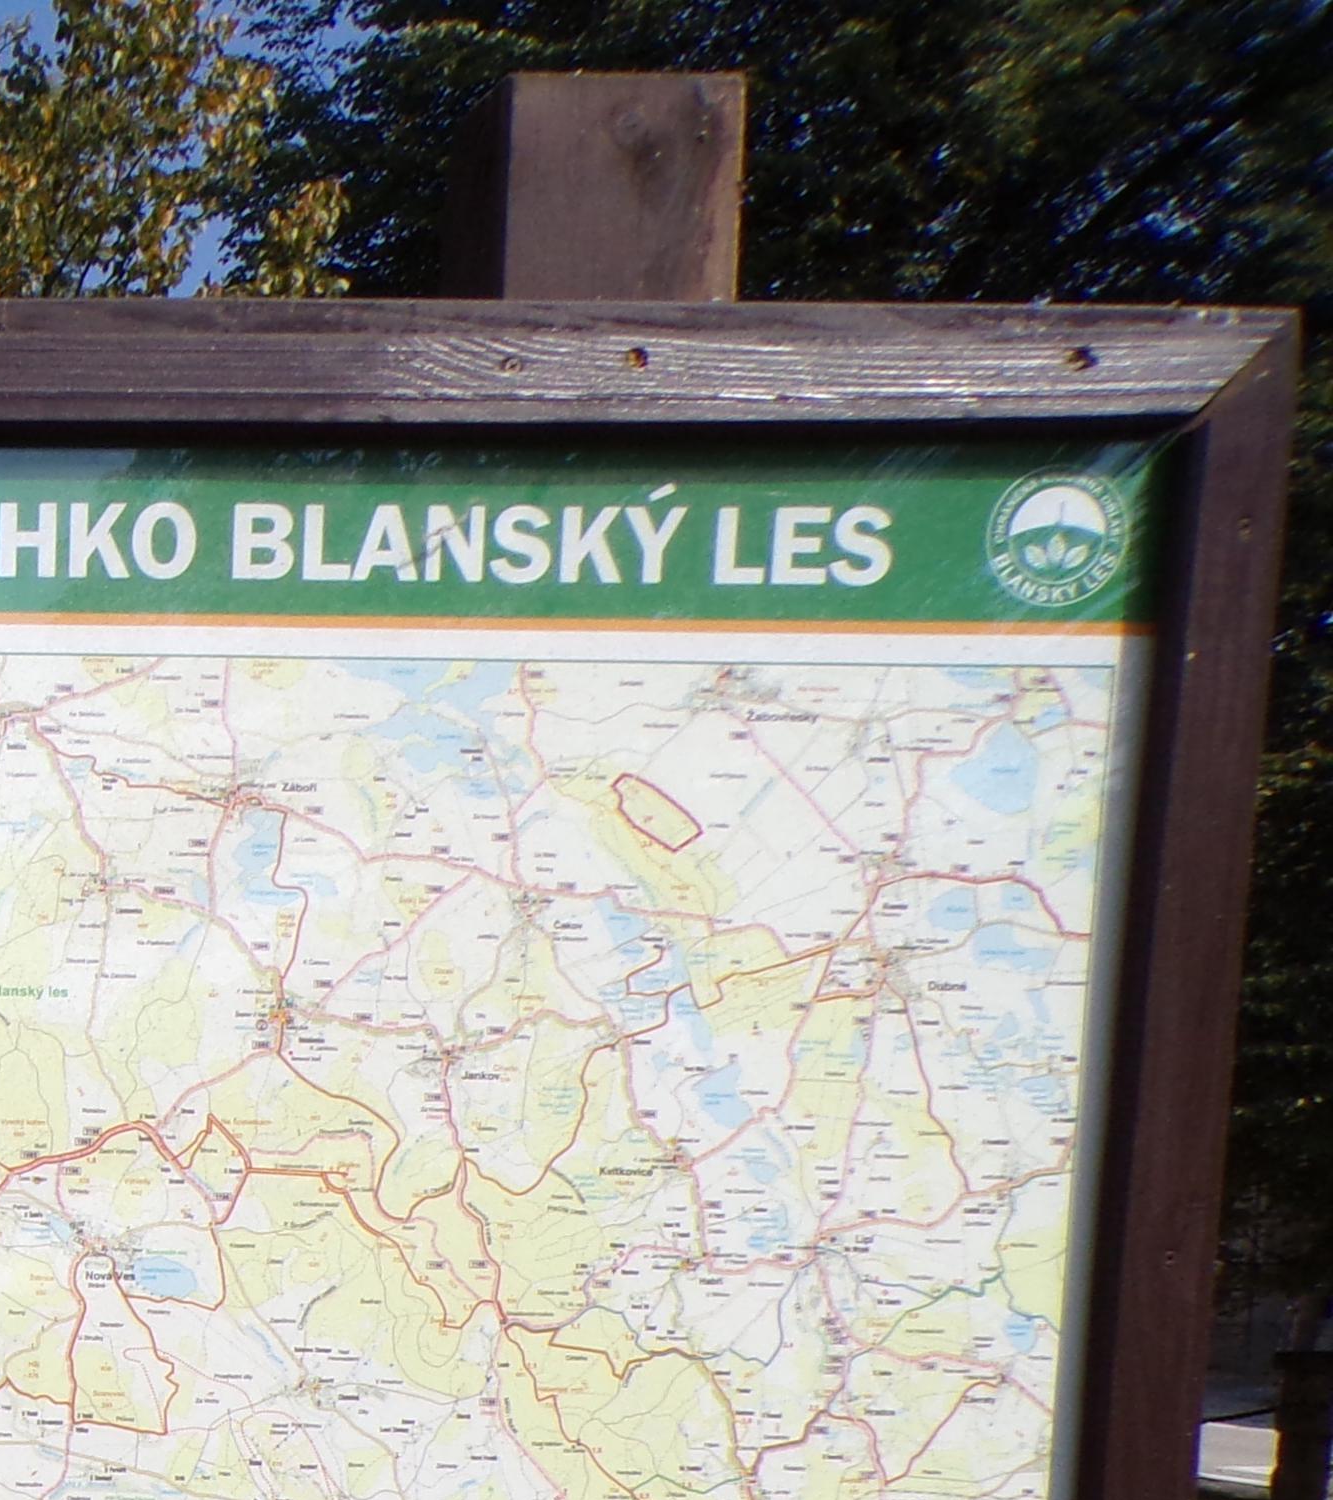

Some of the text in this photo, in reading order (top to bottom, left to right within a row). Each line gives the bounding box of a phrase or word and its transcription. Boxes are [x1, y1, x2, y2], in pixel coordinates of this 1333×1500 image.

[229, 481, 686, 585] BLANSKÝ
[714, 505, 894, 587] LES
[48, 986, 68, 997] les
[461, 1071, 500, 1081] Jankov
[117, 1271, 135, 1281] Ves
